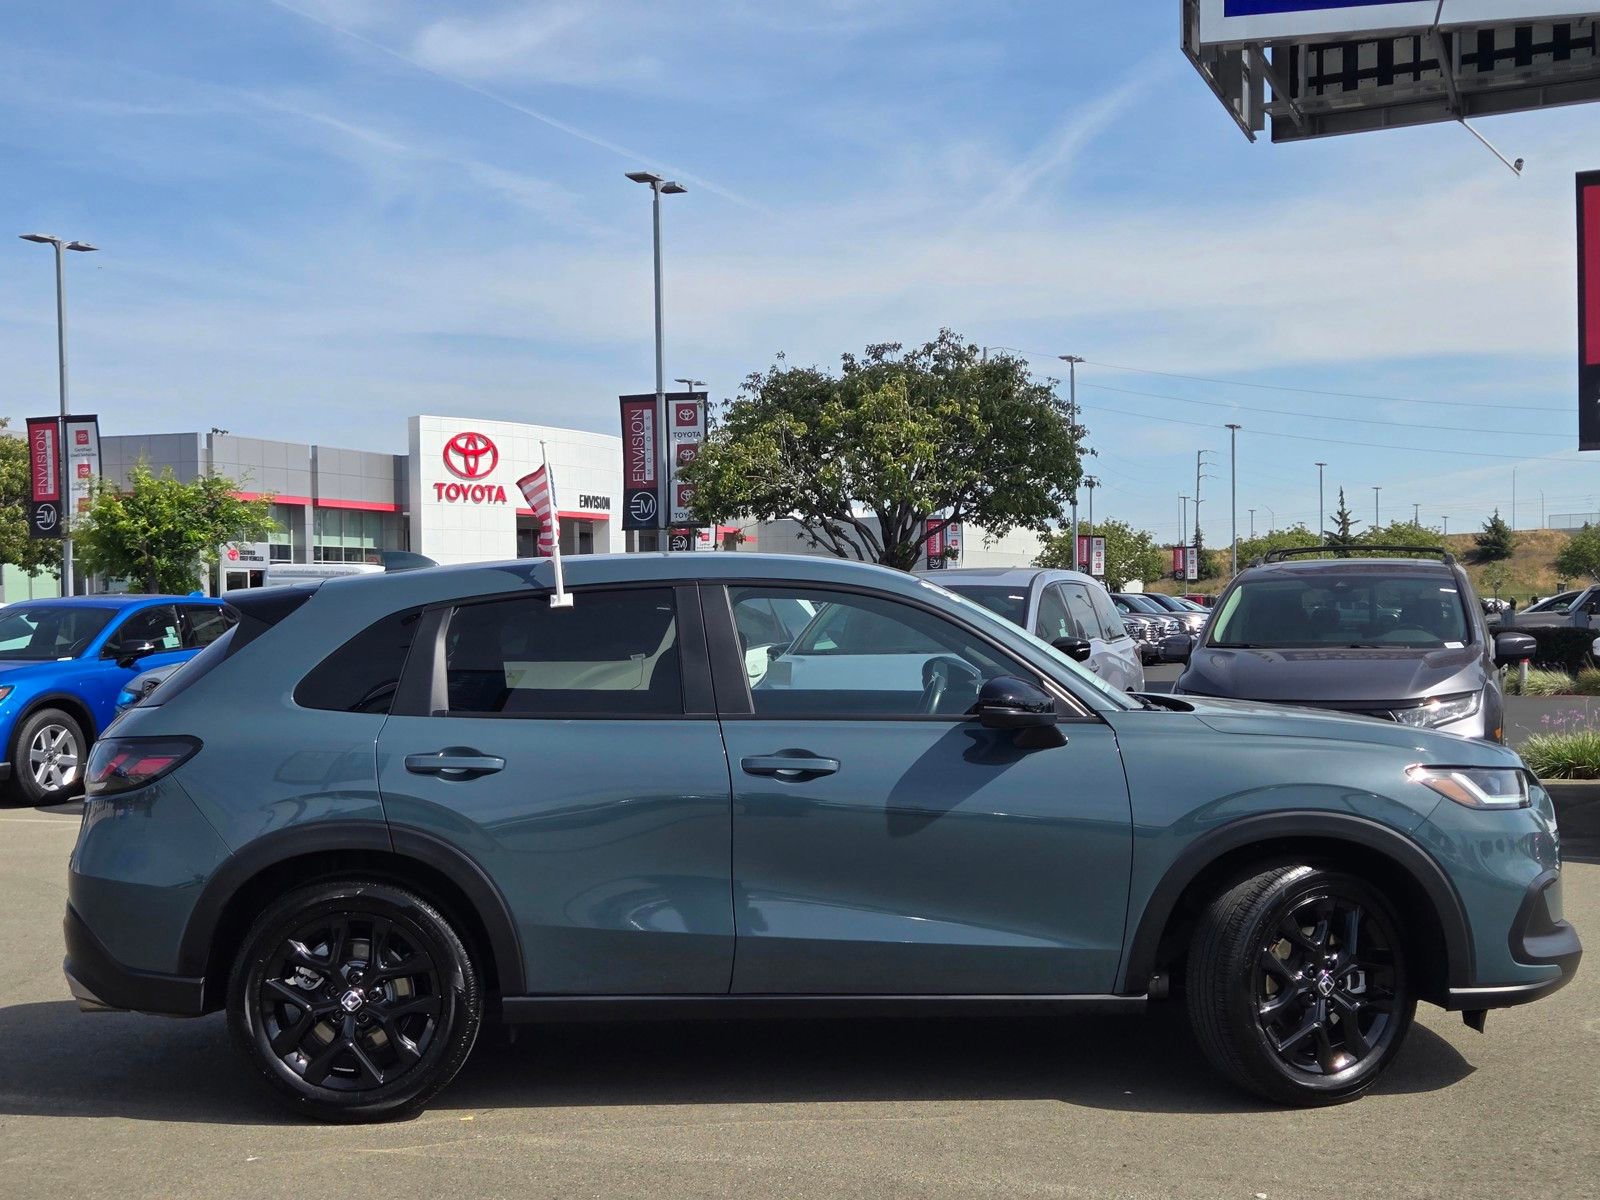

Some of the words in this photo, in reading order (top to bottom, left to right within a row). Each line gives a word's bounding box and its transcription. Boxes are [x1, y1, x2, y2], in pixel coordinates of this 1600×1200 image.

[631, 409, 645, 482] ENVISION
[673, 430, 702, 439] TOYOTA
[35, 429, 48, 496] ENVISION
[433, 482, 508, 505] TOYOTA
[579, 494, 611, 510] ENVISION
